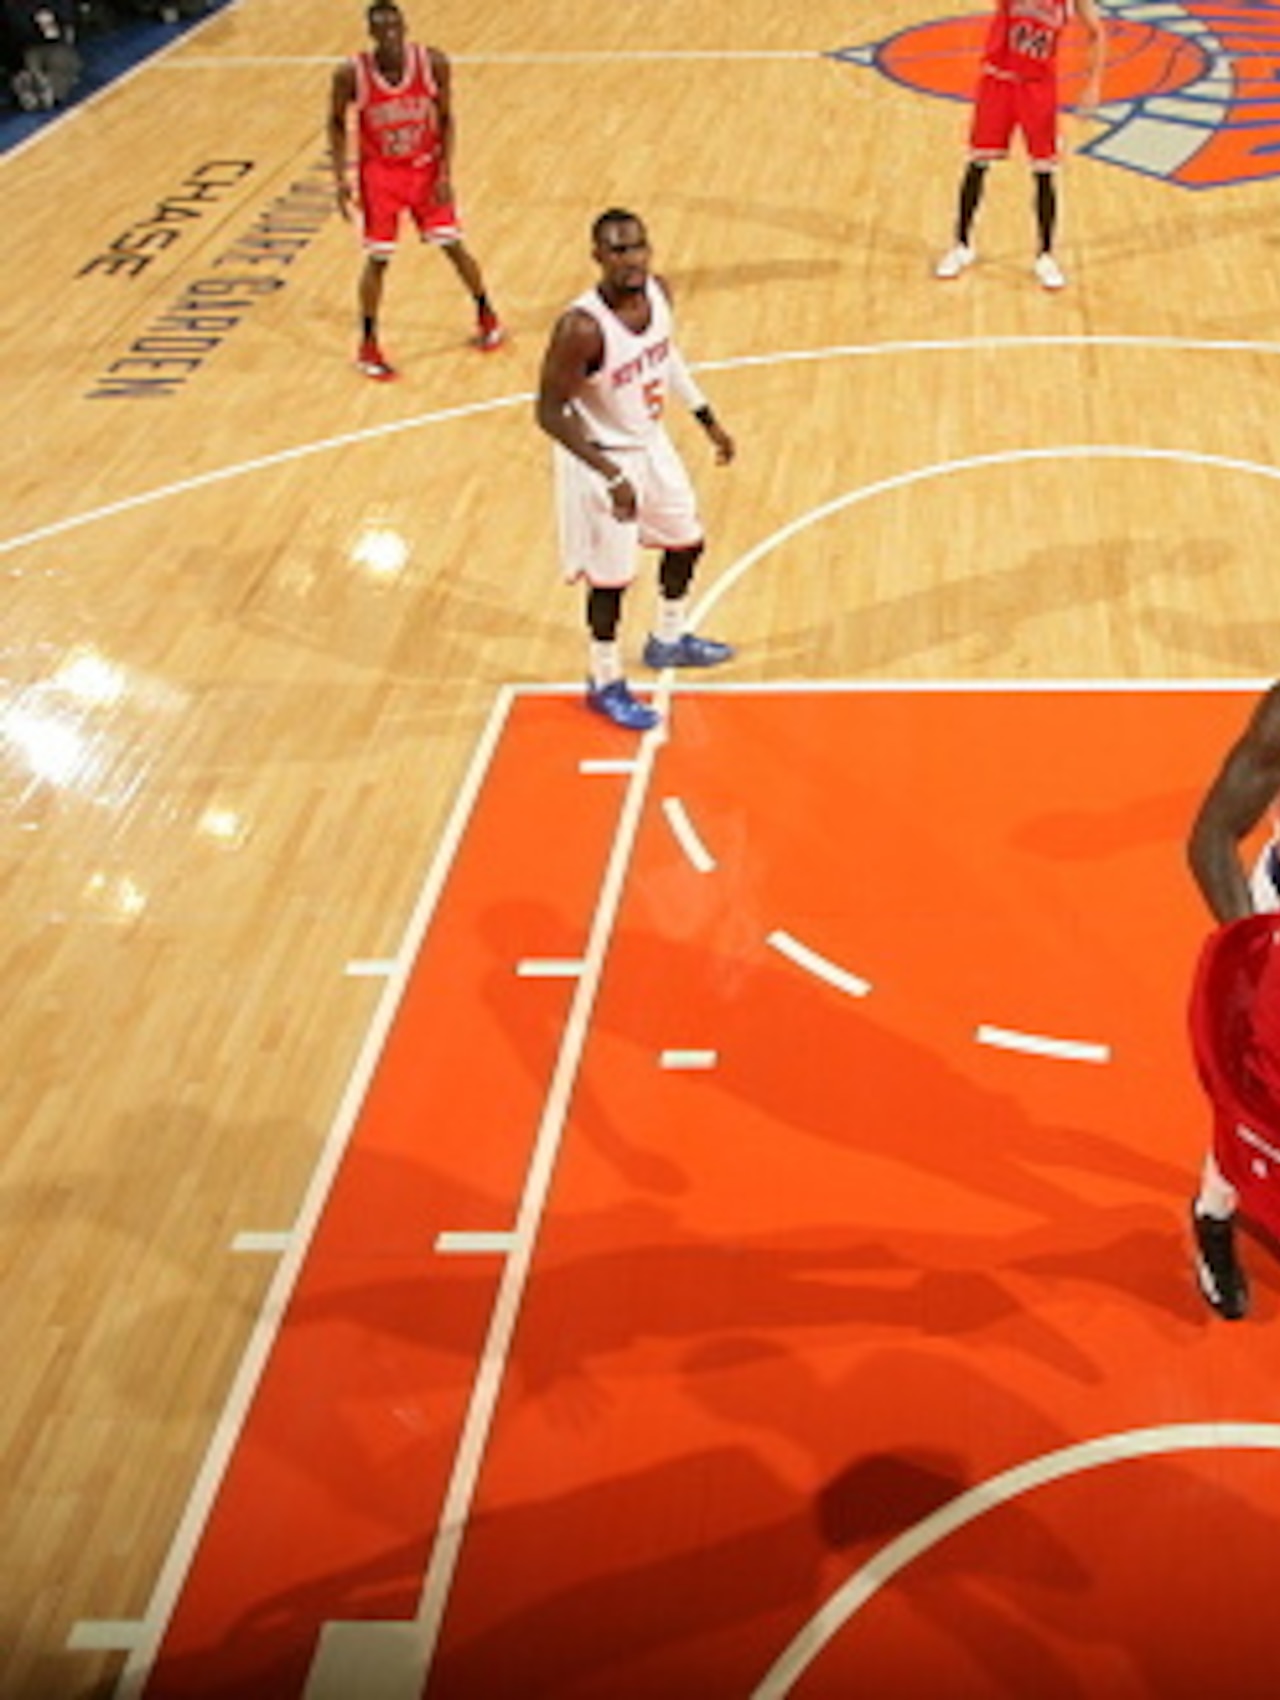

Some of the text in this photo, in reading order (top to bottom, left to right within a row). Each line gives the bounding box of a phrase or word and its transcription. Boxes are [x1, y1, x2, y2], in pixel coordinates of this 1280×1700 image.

[74, 159, 255, 280] CHASE
[83, 276, 287, 399] GARDEN
[642, 379, 664, 421] 5
